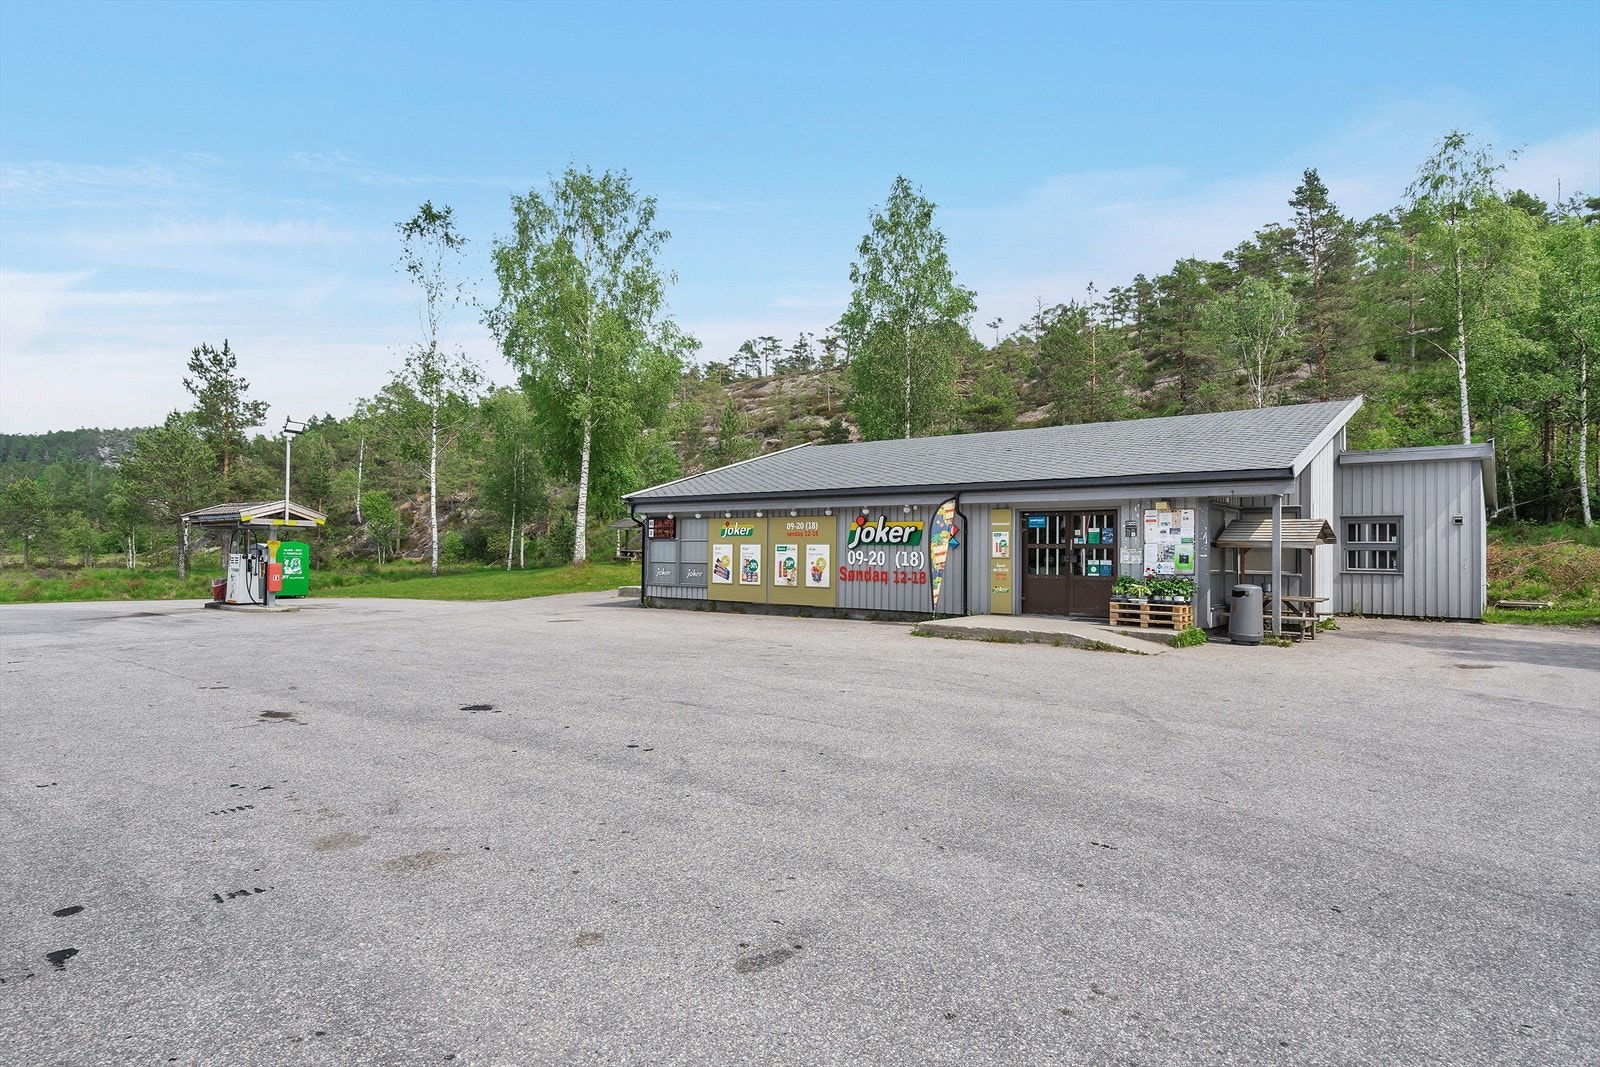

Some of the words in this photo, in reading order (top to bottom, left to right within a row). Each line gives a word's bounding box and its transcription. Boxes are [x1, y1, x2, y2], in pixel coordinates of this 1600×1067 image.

[721, 521, 752, 539] joker
[786, 522, 804, 530] 09-20
[805, 521, 819, 531] (18)
[848, 515, 915, 549] joker
[847, 550, 886, 566] 09-20
[895, 550, 925, 570] (18)
[656, 567, 672, 578] joker
[686, 568, 703, 579] joker
[839, 565, 889, 585] Søndag
[893, 570, 927, 585] 12-18
